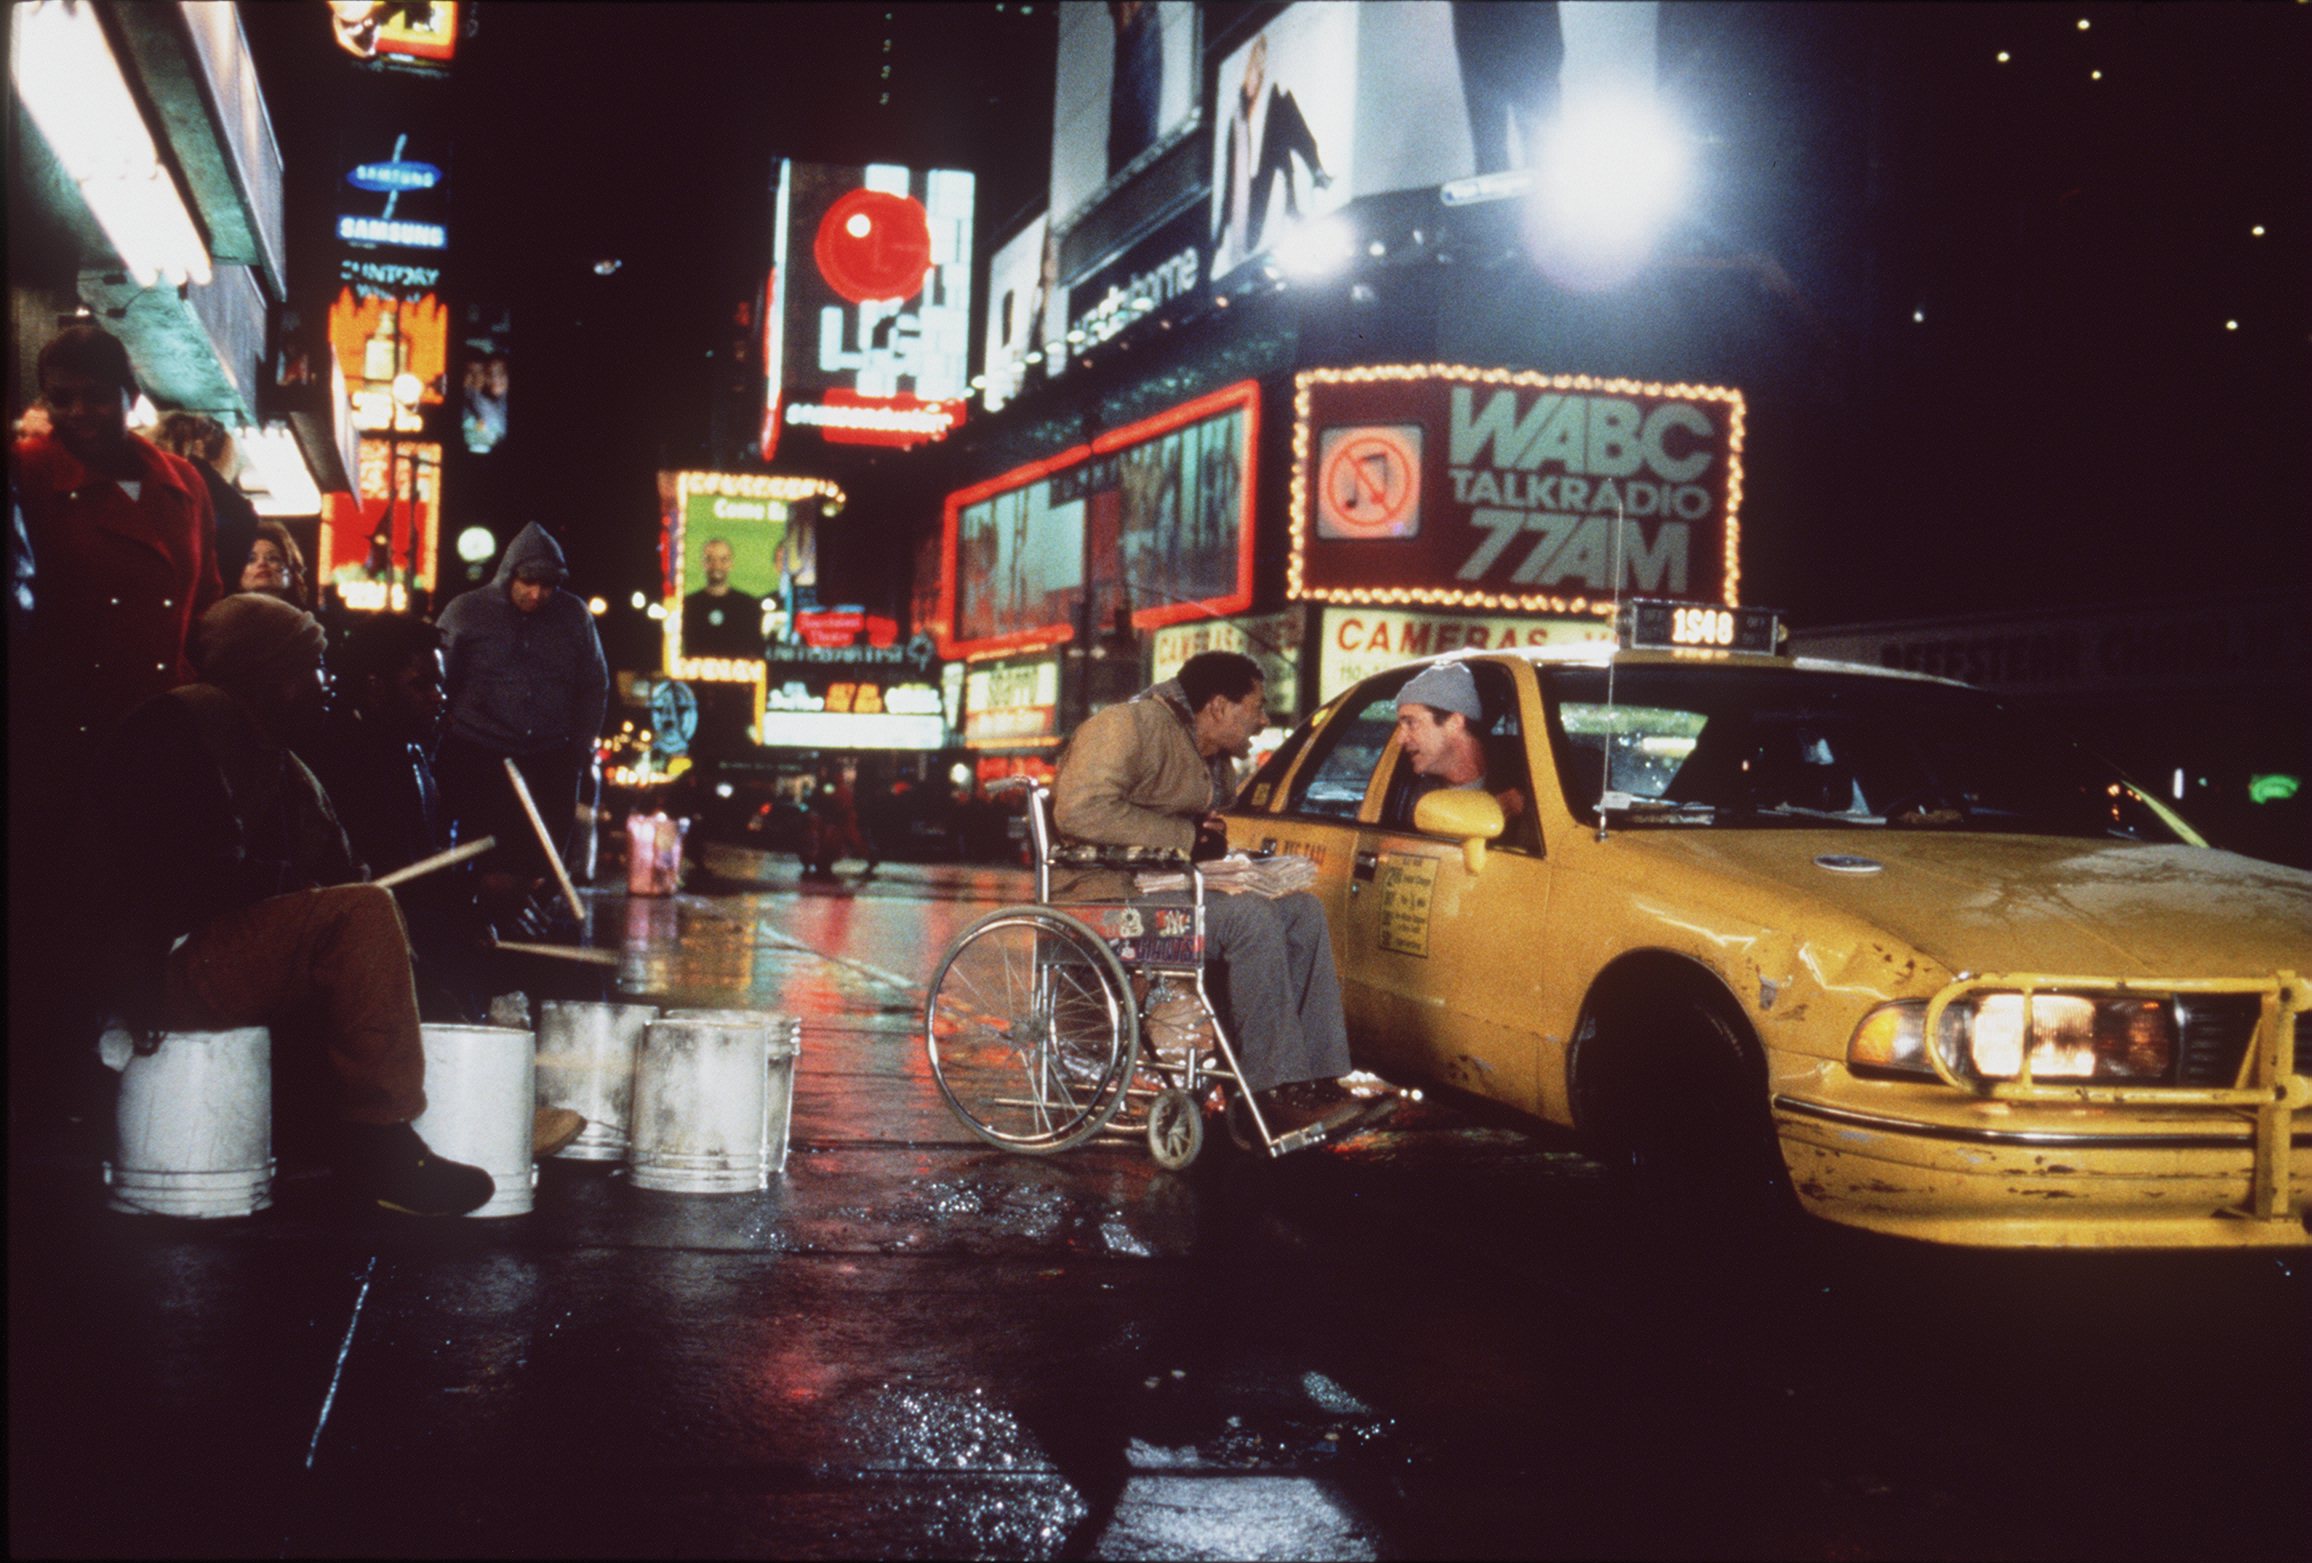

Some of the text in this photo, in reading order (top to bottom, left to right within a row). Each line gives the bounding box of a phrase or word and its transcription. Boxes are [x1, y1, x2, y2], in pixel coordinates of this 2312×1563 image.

[356, 165, 434, 188] SAMSUNG
[340, 217, 444, 247] SAMSUNG
[1448, 384, 1714, 483] WABC
[1456, 507, 1692, 594] 77AM
[1336, 618, 1550, 656] CAMERAS
